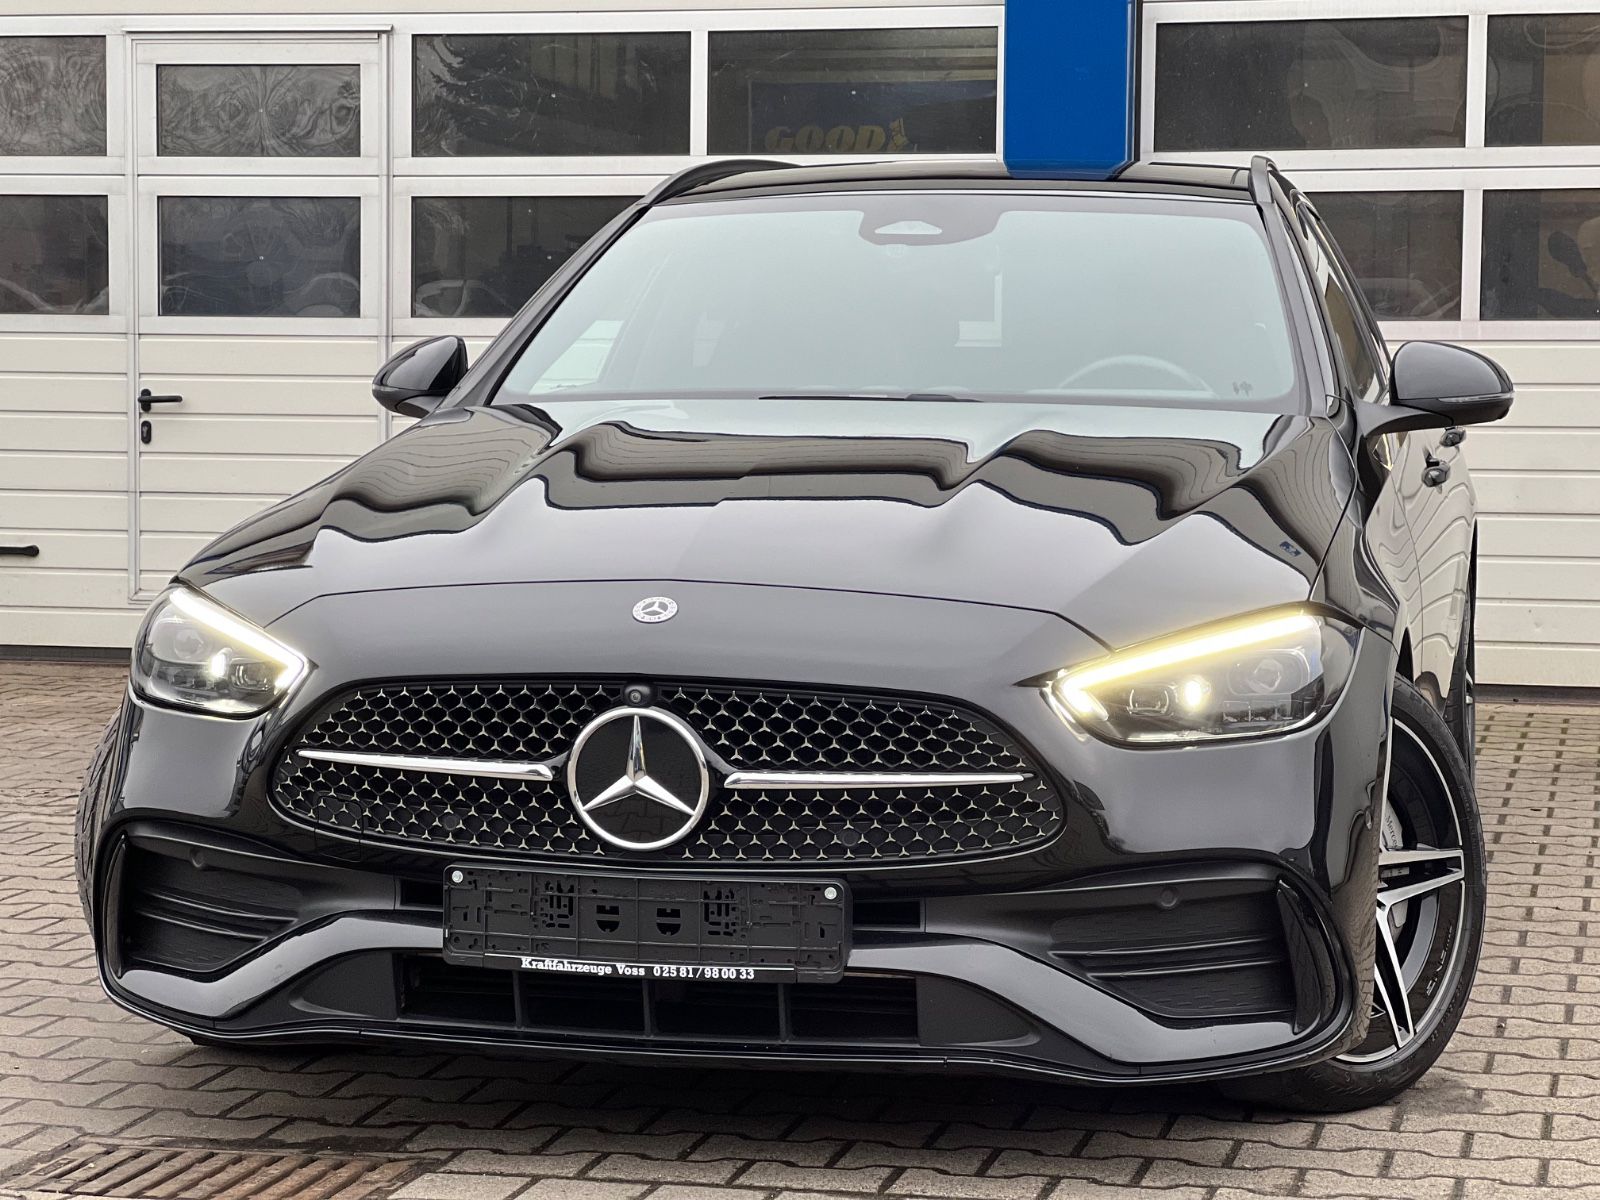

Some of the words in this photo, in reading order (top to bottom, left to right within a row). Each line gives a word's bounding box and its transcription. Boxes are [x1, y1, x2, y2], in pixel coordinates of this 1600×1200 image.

[764, 125, 886, 153] GOOD
[521, 958, 612, 975] Kraftfahrzeuge
[616, 963, 645, 976] Voss
